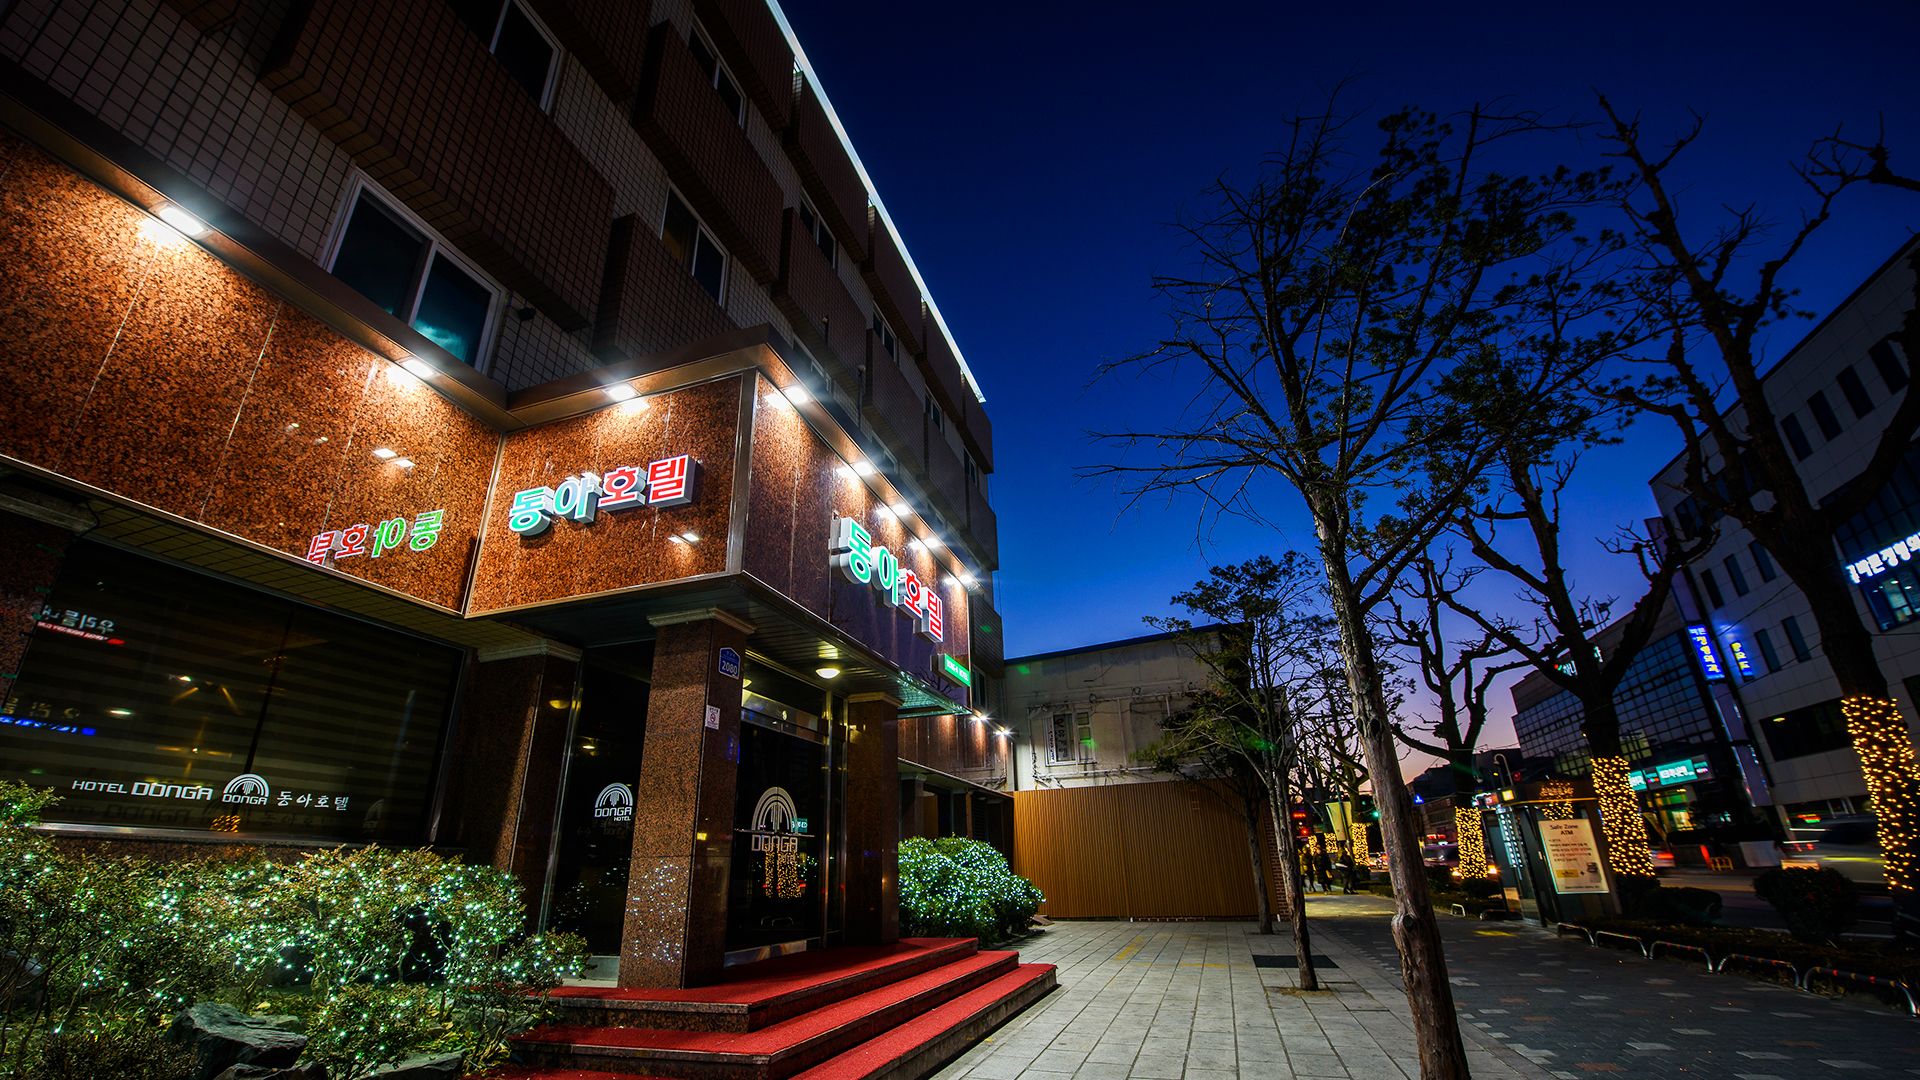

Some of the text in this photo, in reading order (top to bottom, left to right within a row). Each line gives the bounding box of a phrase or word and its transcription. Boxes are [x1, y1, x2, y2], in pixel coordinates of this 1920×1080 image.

[508, 454, 691, 533] 동아호텔
[847, 517, 944, 643] 동아호텔
[722, 660, 738, 675] 2080
[71, 780, 214, 801] HOTEL DONGA
[222, 793, 269, 806] DONGA
[276, 789, 349, 811] 동아호텔
[594, 806, 633, 818] DONGA
[751, 834, 798, 852] DONGA
